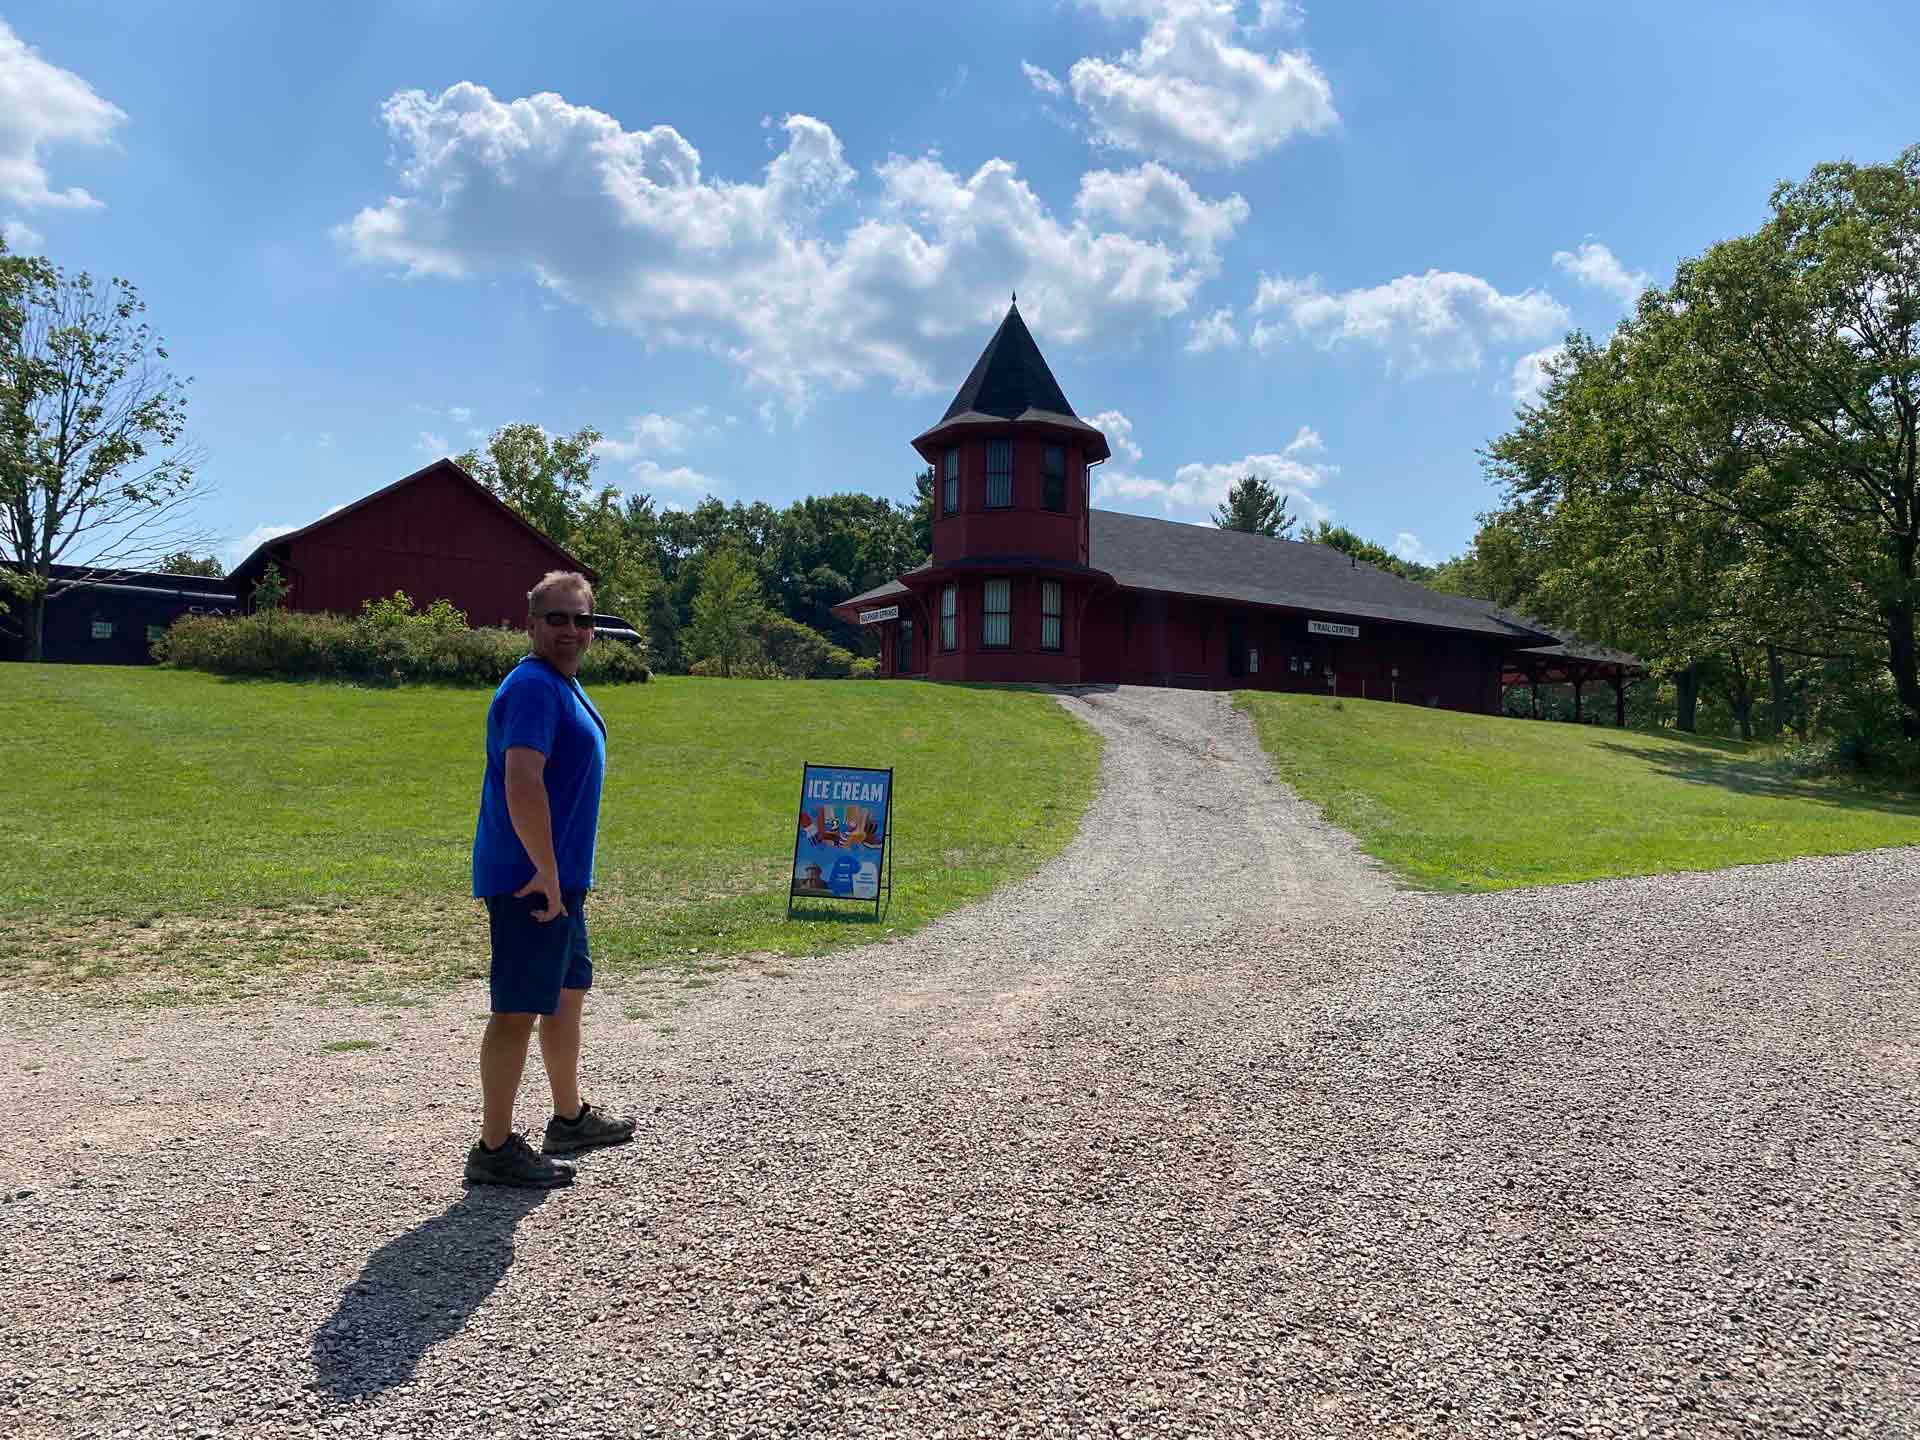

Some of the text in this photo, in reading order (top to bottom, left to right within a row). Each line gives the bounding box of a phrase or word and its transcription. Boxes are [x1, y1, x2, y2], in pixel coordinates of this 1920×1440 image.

[1313, 623, 1330, 632] TRAIL
[808, 779, 883, 801] ICE CREAM
